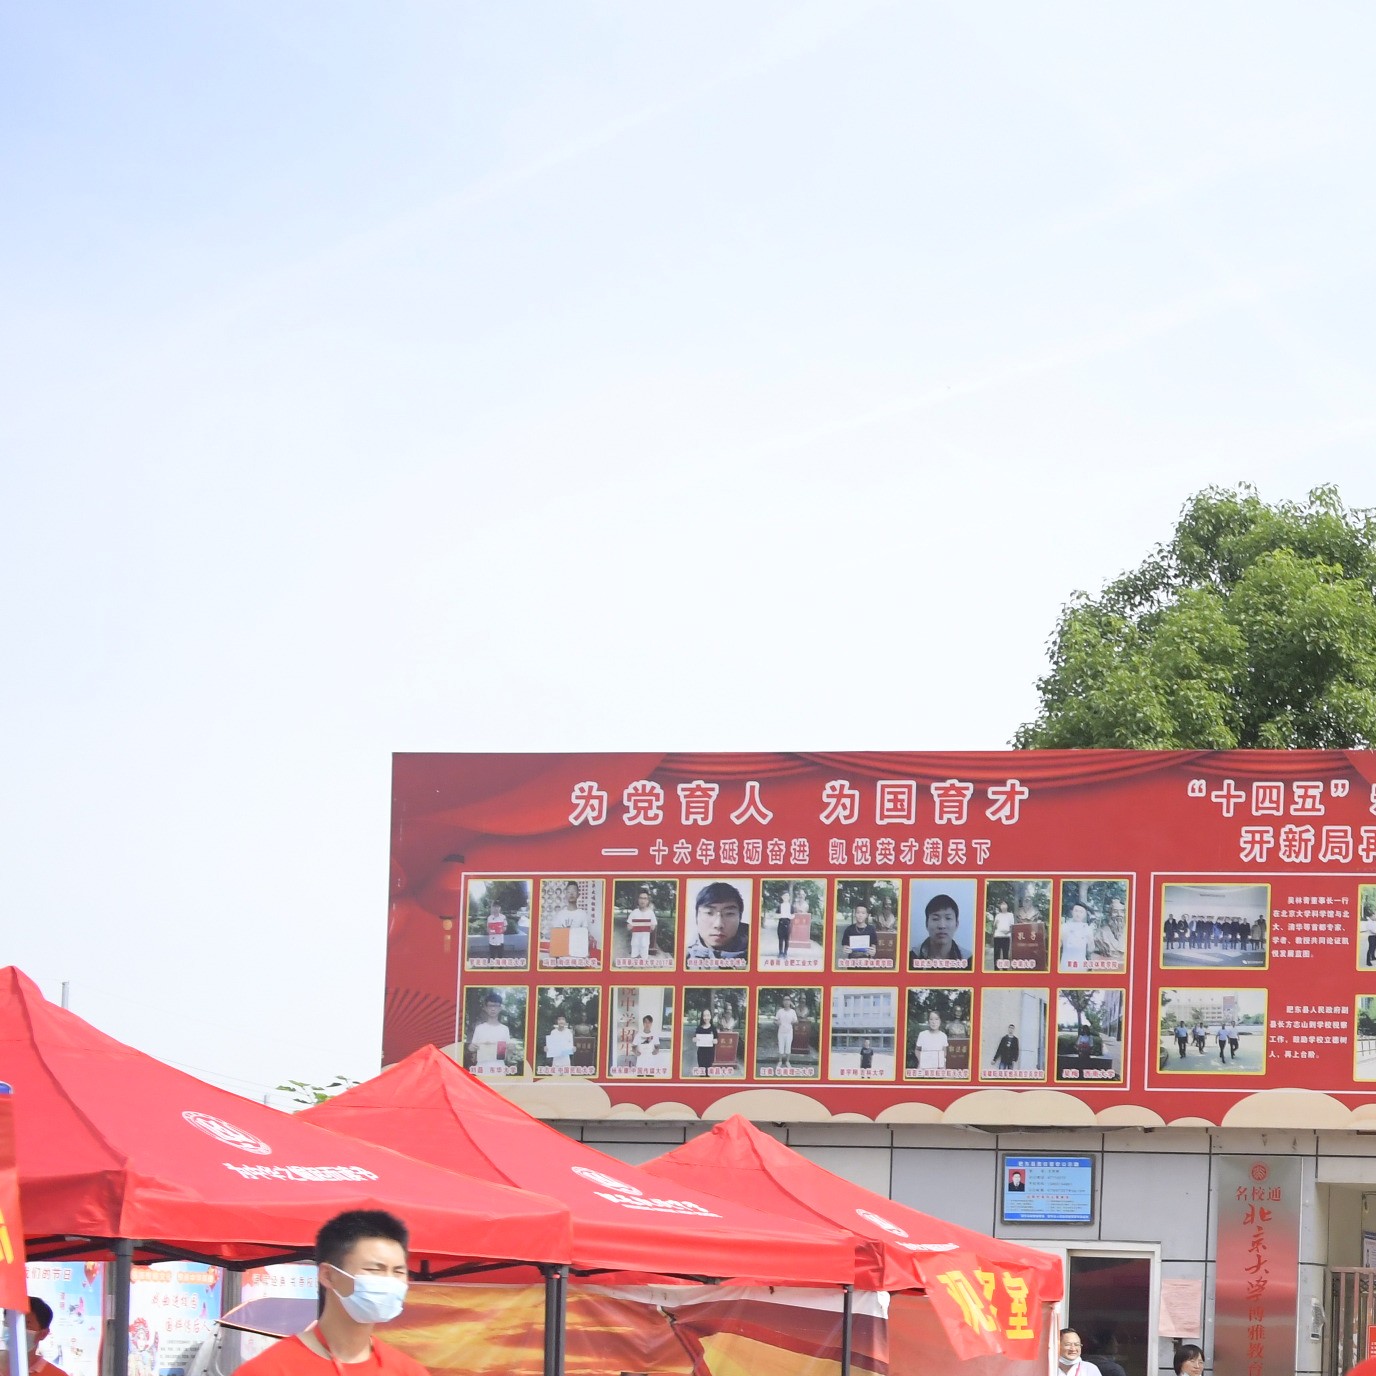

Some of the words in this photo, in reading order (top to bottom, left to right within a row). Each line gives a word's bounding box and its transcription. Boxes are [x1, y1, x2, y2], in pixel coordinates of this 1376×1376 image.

[569, 780, 773, 825] 为党育人
[819, 780, 1029, 824] 为国育才
[1187, 779, 1350, 817] “十四五”
[828, 838, 992, 866] 凯悦英才满天下
[1236, 1186, 1282, 1202] 名校通
